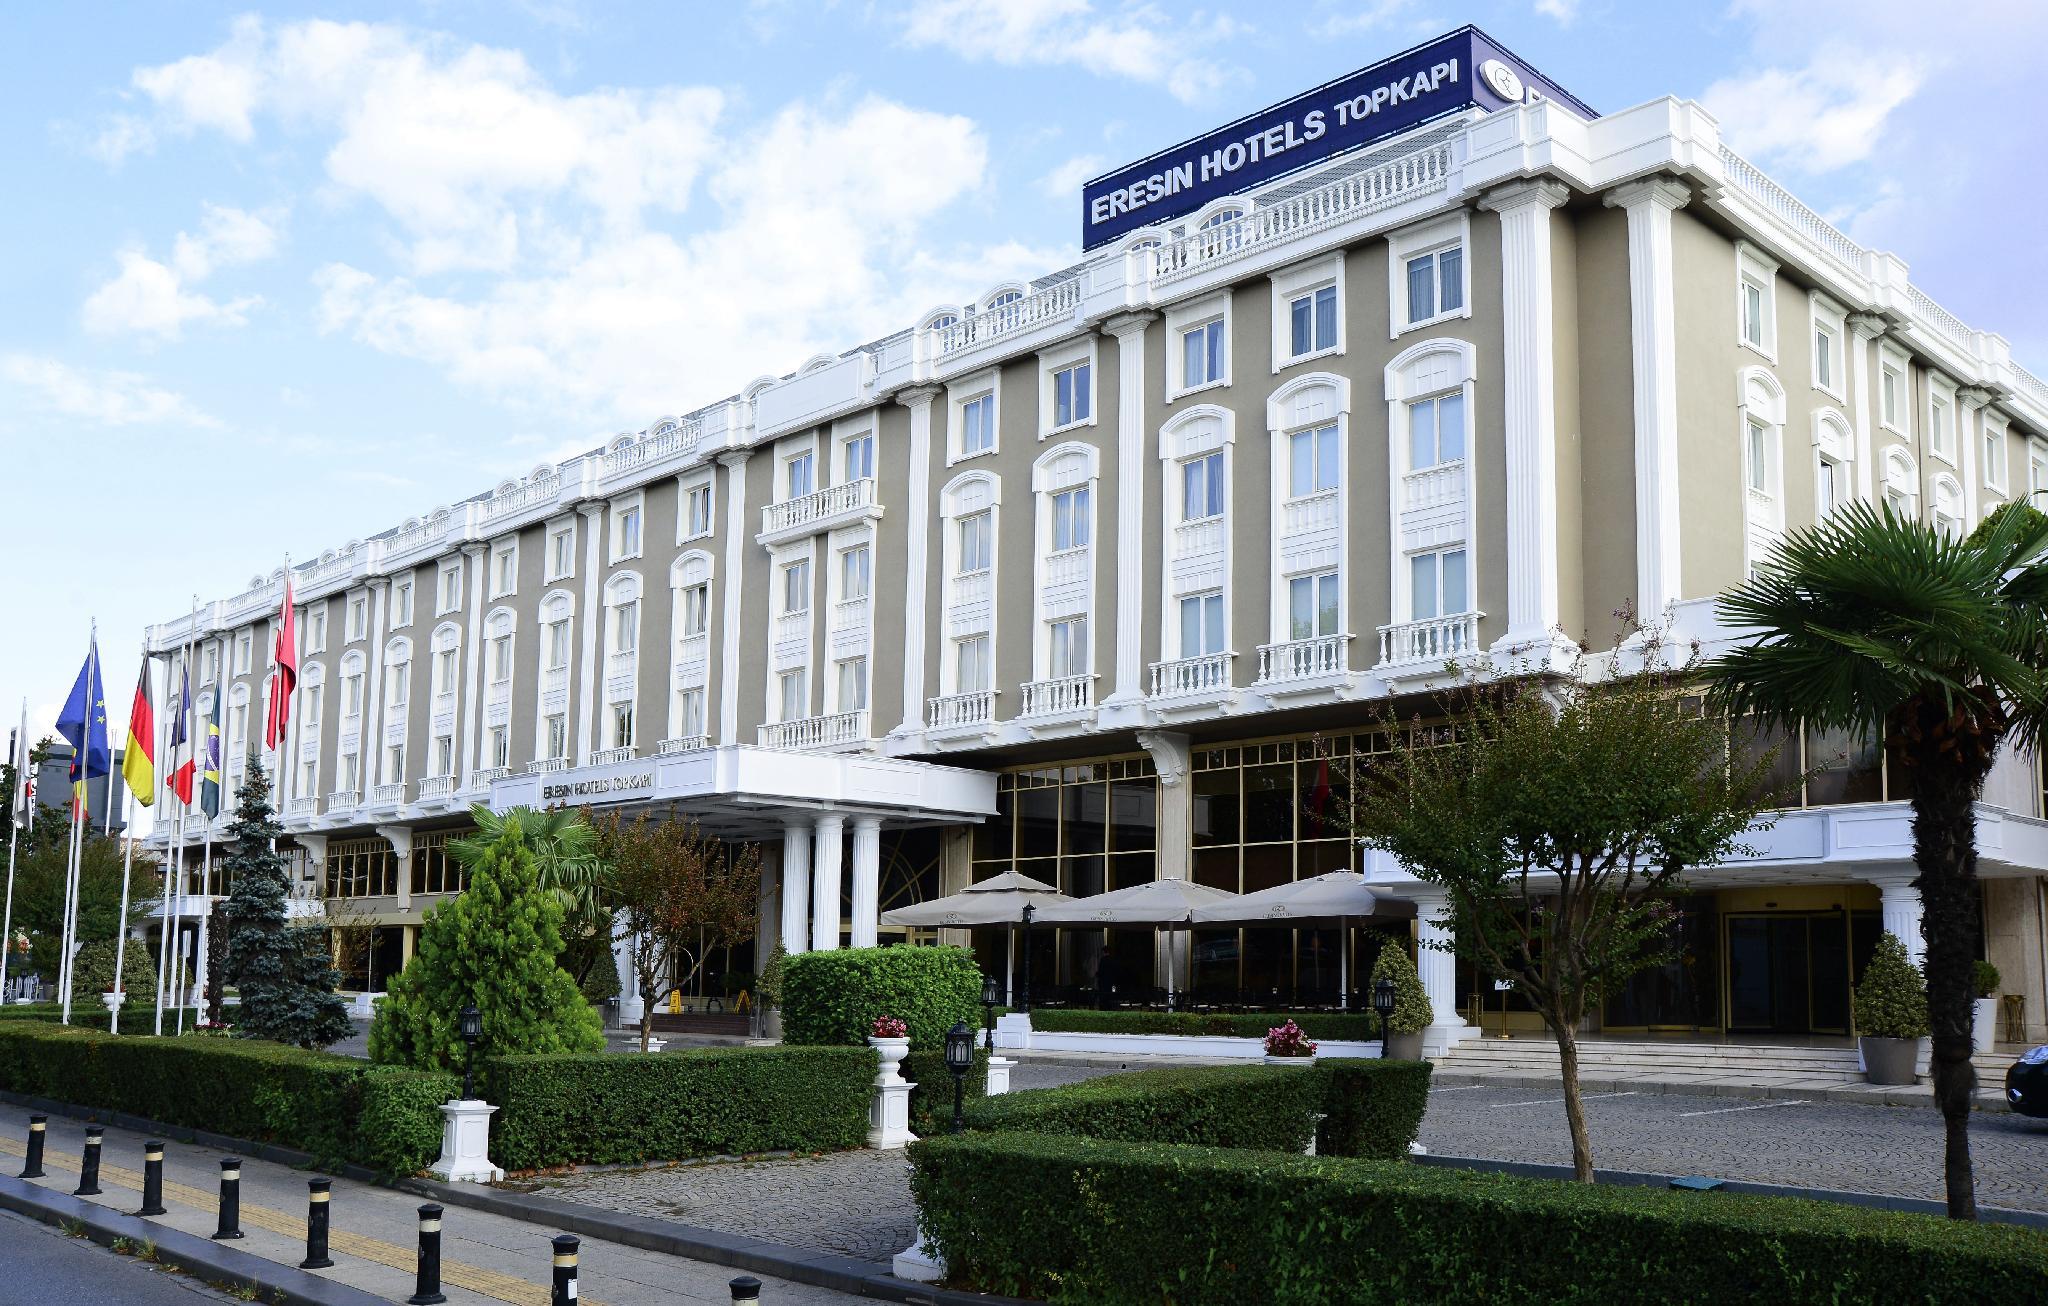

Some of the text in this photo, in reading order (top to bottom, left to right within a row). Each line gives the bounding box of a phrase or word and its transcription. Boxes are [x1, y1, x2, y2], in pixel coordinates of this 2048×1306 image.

[1091, 58, 1458, 225] ERESIN HOTELS TOPKAPI
[543, 773, 652, 799] ERESIN HOTELS TOPKAPI
